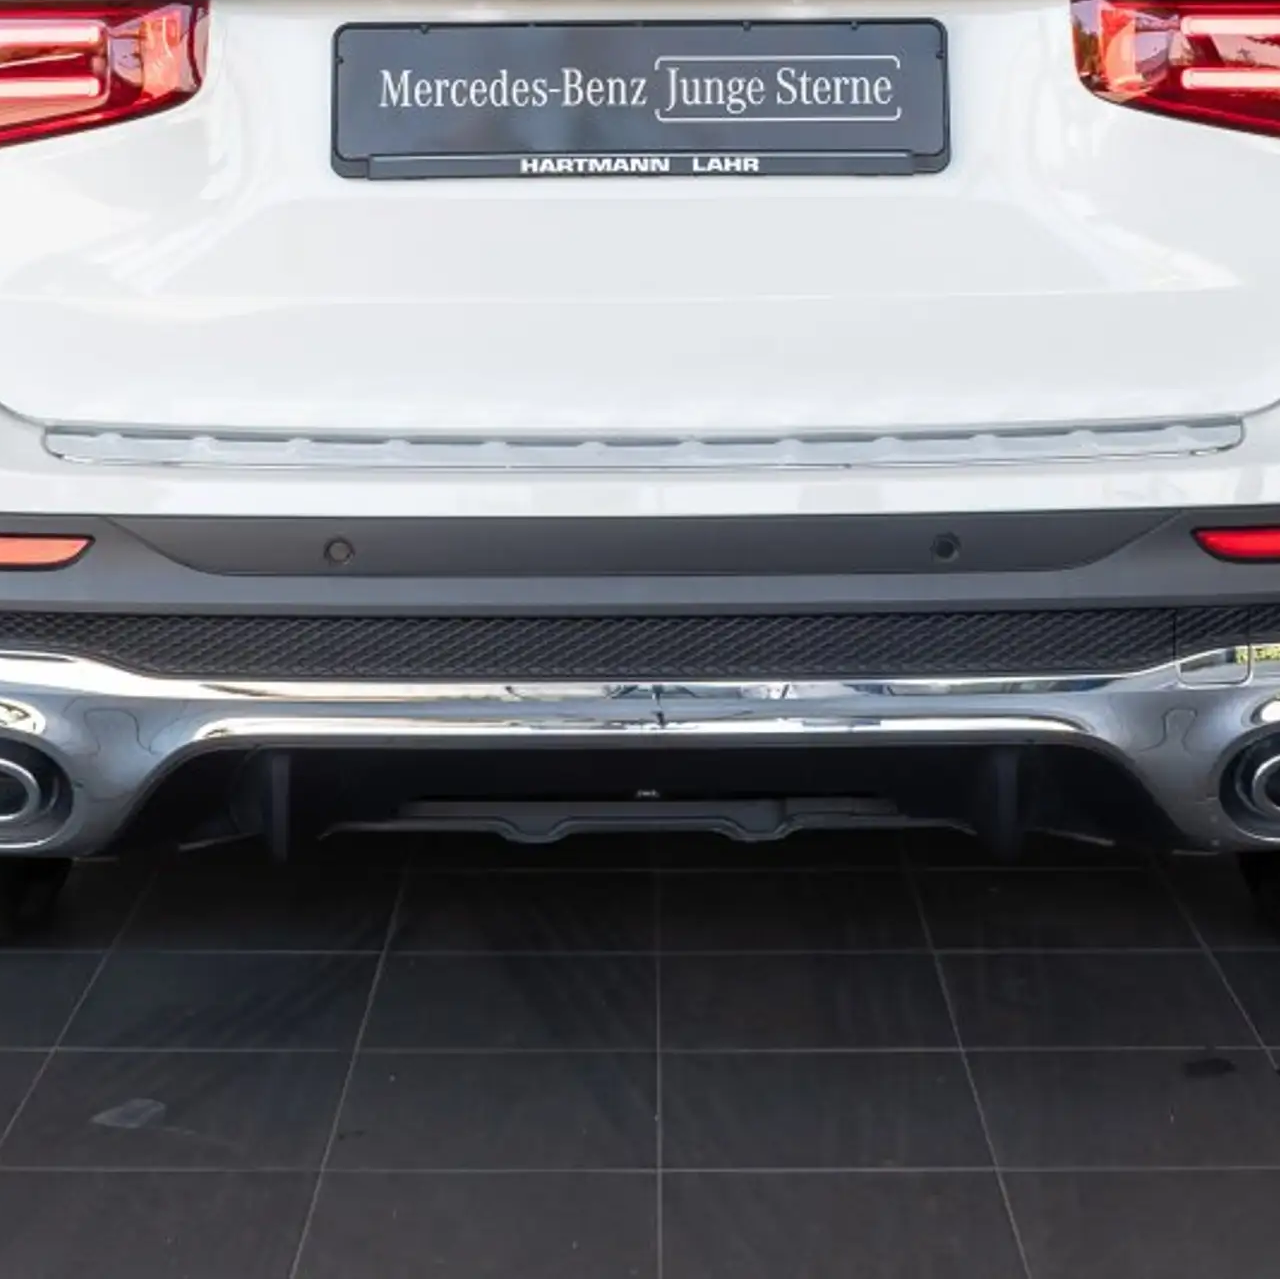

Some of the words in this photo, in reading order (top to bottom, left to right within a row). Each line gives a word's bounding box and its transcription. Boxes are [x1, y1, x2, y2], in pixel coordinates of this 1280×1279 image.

[379, 67, 648, 108] Mercedes-Benz
[665, 67, 765, 114] Junge
[776, 67, 892, 105] Sterne
[520, 158, 670, 174] HARTMANN
[692, 157, 760, 172] LAHR
